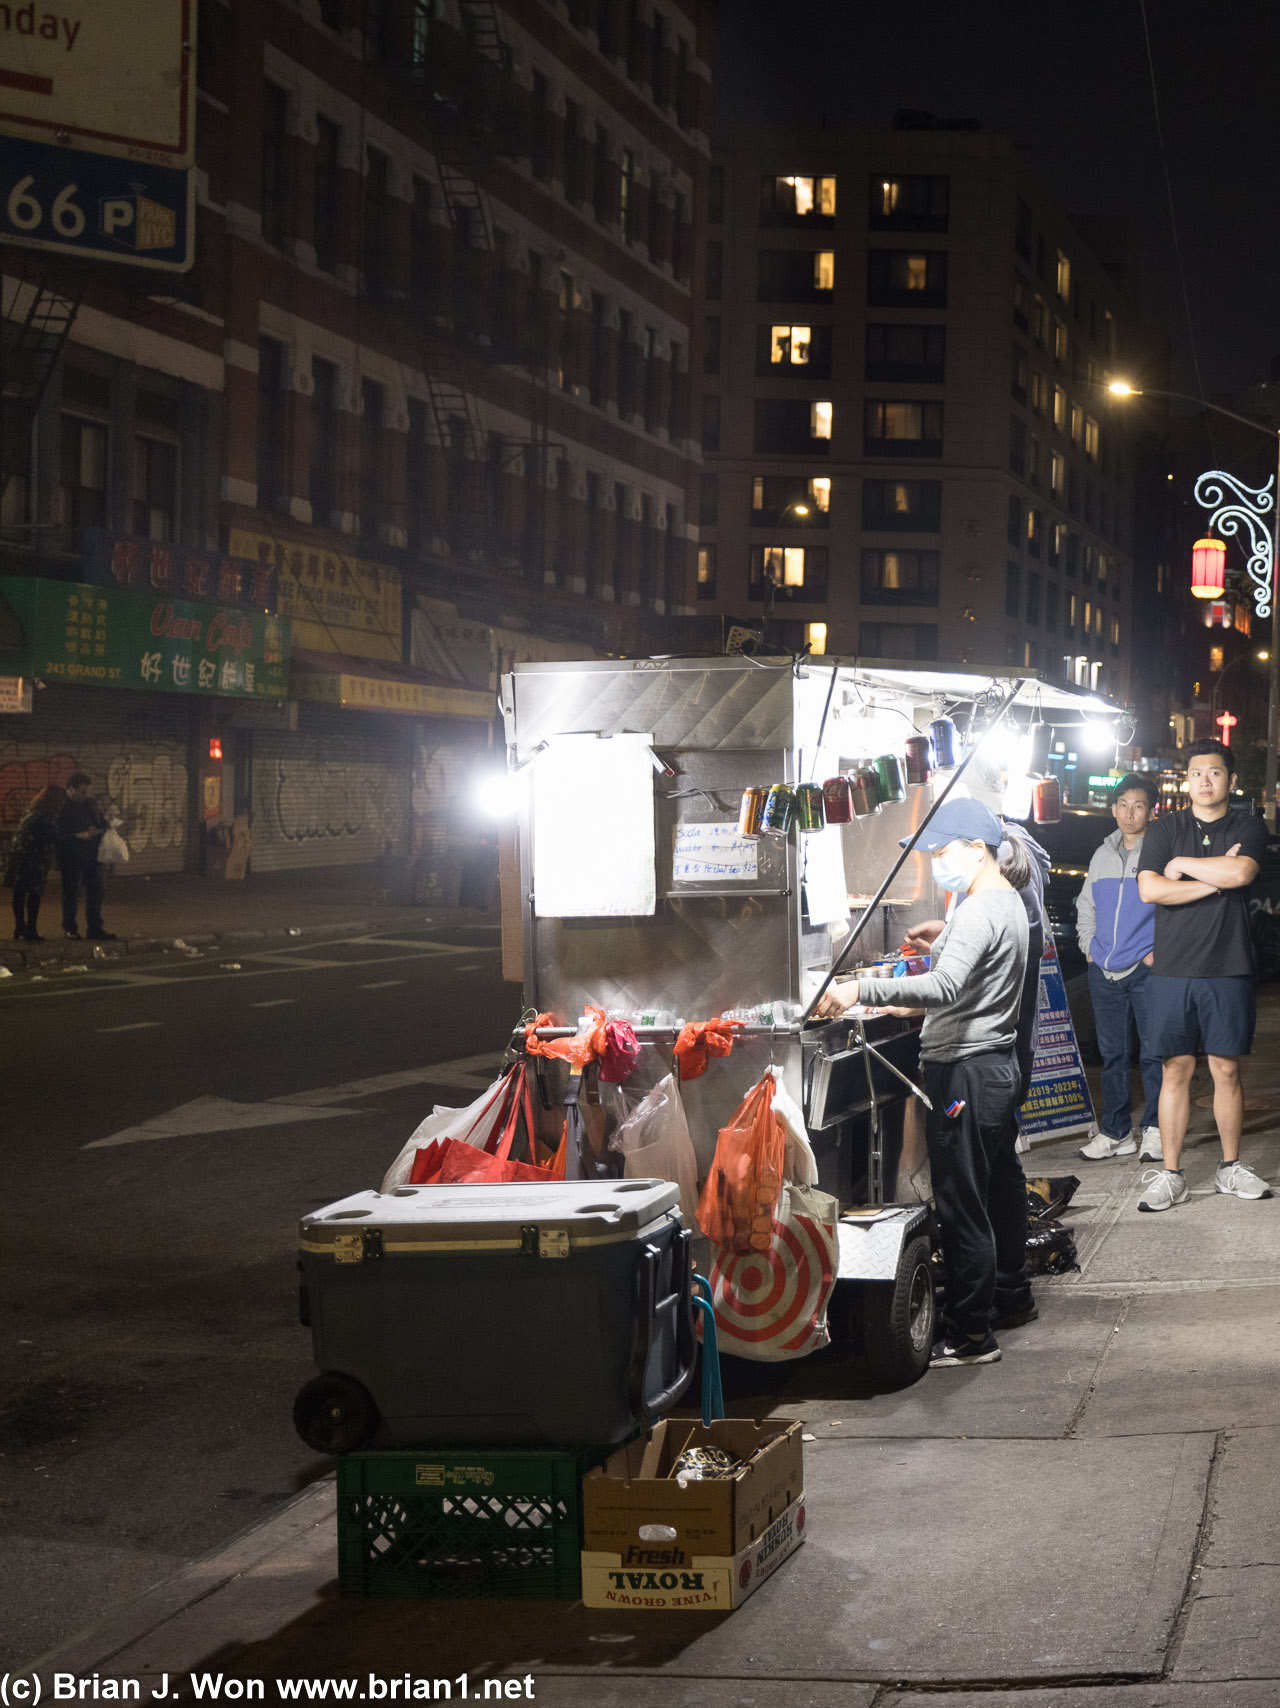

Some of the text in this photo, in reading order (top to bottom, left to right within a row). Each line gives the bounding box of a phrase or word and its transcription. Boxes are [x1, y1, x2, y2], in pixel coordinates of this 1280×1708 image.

[626, 1545, 685, 1565] Fresh
[608, 1572, 705, 1590] ROYAL
[606, 1590, 713, 1607] VINE GROWN
